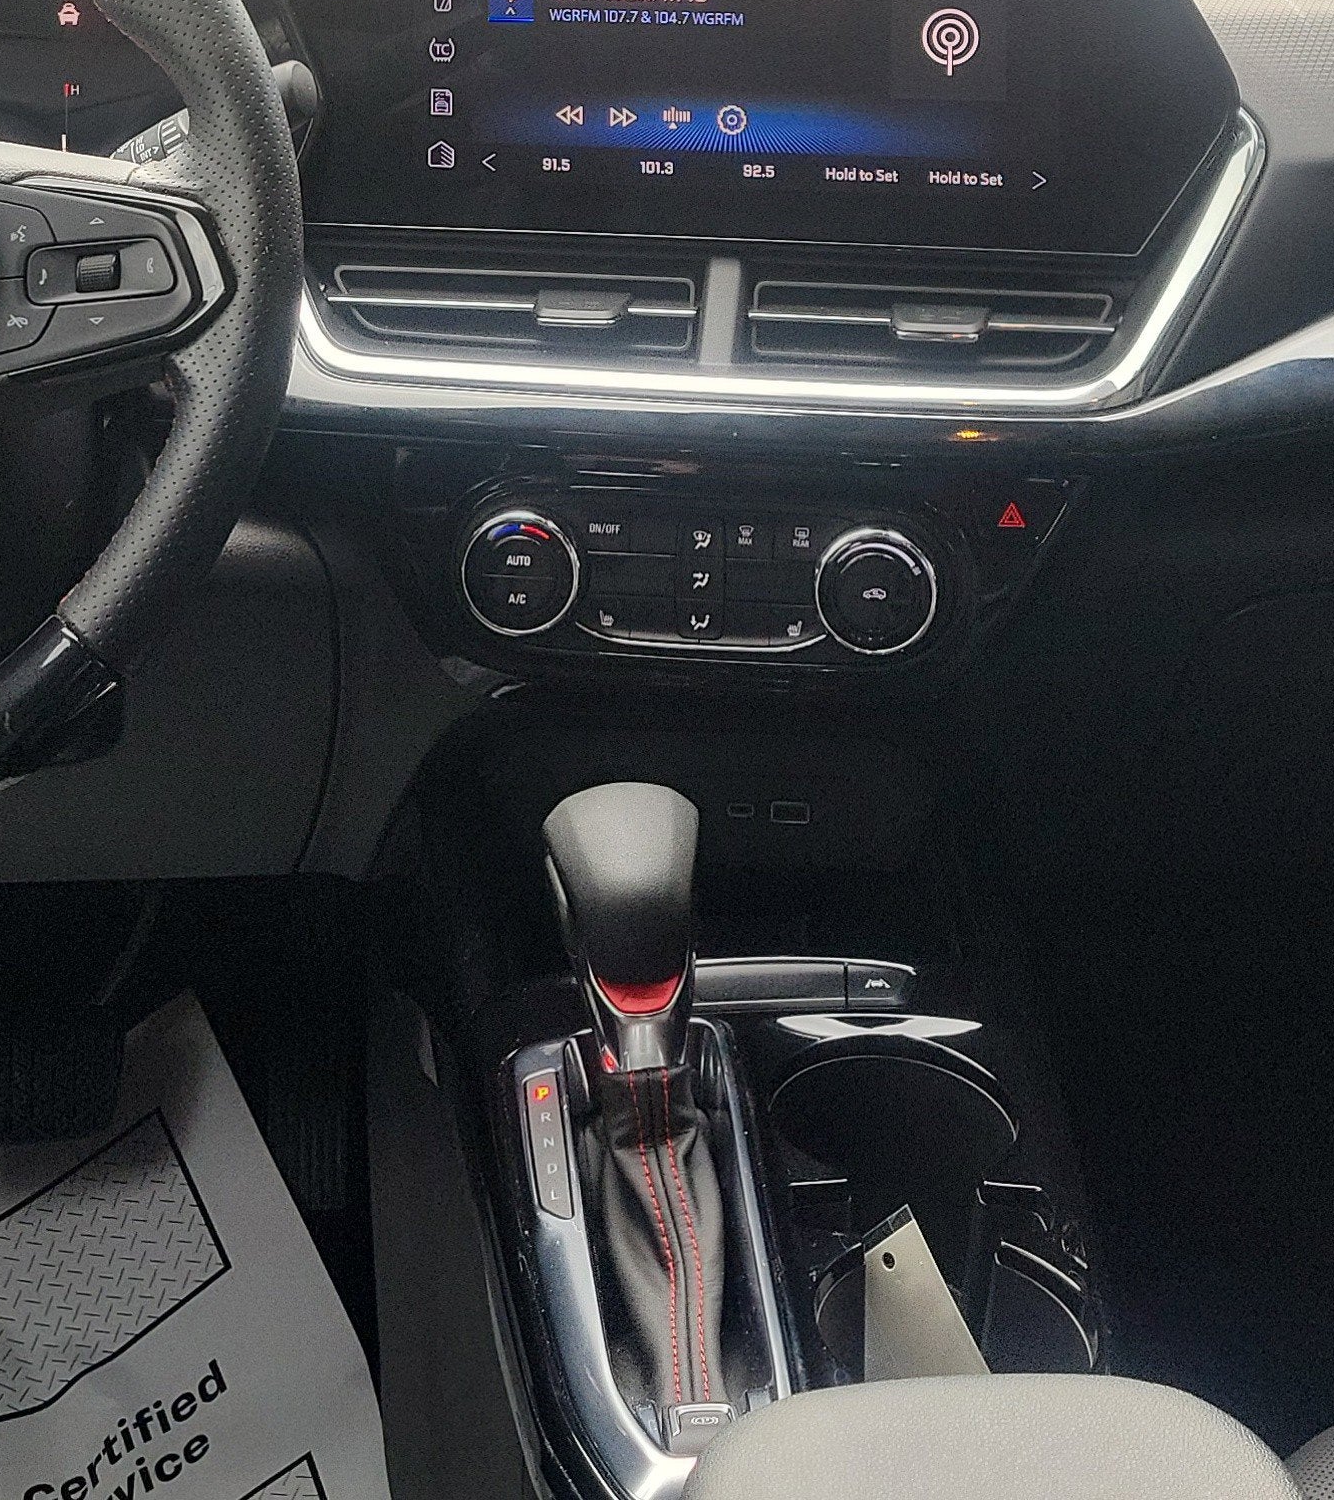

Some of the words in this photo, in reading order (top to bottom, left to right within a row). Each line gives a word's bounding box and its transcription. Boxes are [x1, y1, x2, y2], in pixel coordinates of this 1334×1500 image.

[549, 8, 600, 23] WGRFM
[604, 9, 638, 23] 107.7
[641, 10, 652, 23] &
[654, 10, 689, 24] 104.7
[692, 12, 744, 26] WGRFM
[433, 43, 450, 55] TC
[70, 84, 80, 96] H
[542, 157, 571, 171] 91.5
[640, 160, 674, 175] 101.3
[742, 164, 775, 178] 92.5
[825, 167, 857, 181] Hold
[859, 169, 874, 182] to
[876, 169, 899, 183] Set
[929, 171, 961, 185] Hold
[963, 172, 978, 185] to
[980, 173, 1003, 187] Set
[588, 522, 622, 534] ON/OFF
[506, 554, 531, 566] AUTO
[508, 593, 527, 605] A/C
[538, 1085, 550, 1101] P
[540, 1111, 552, 1123] R
[543, 1136, 555, 1149] N
[547, 1163, 558, 1175] D
[550, 1189, 559, 1201] L
[23, 1358, 228, 1500] Certified
